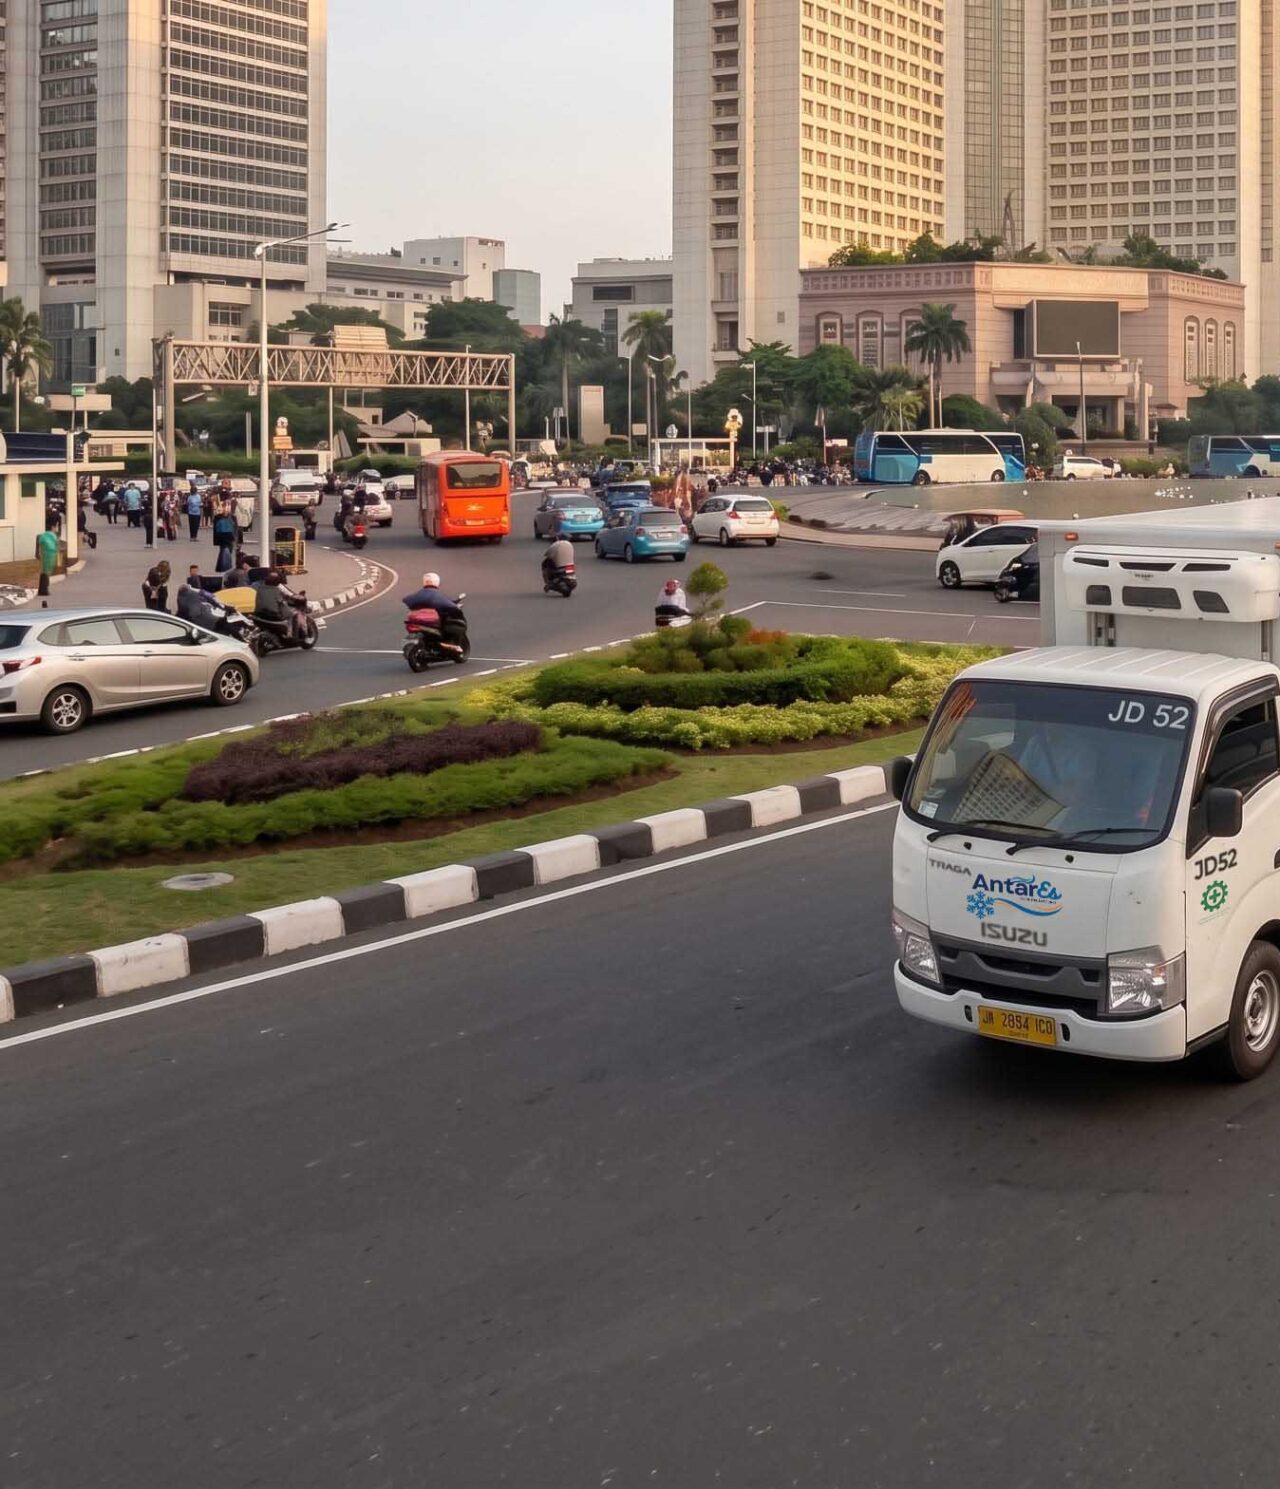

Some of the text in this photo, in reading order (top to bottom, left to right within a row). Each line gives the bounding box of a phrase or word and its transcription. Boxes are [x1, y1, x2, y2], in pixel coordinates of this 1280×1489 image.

[1108, 700, 1189, 729] JD 52
[929, 859, 972, 876] TRAGA
[1194, 848, 1238, 880] JD52
[981, 922, 1048, 947] ISUZU
